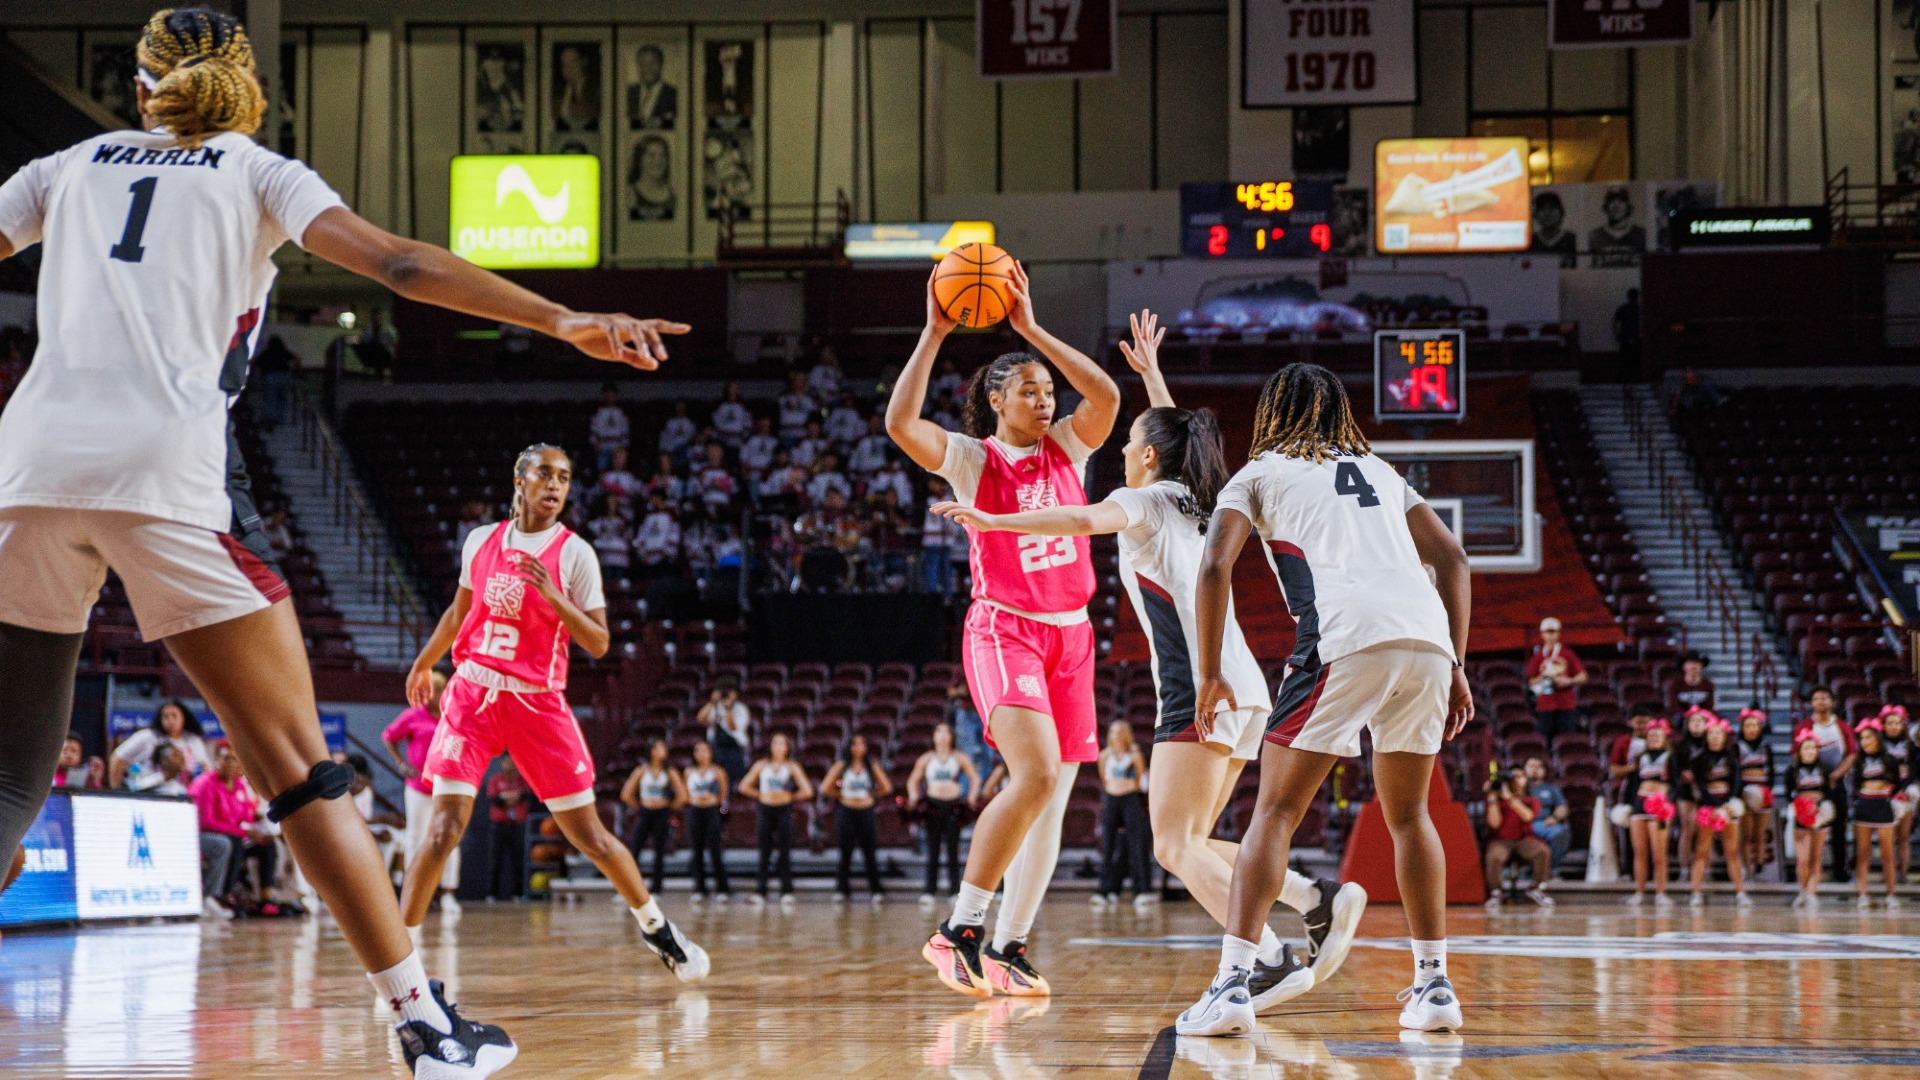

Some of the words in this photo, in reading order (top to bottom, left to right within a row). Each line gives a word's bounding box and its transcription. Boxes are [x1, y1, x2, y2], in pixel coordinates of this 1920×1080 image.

[1010, 0, 1082, 43] 157
[1287, 7, 1371, 38] FOUR
[1599, 14, 1645, 33] WINS
[1025, 47, 1070, 66] WINS
[1285, 51, 1376, 92] 1970
[92, 144, 226, 170] WARREN
[1236, 182, 1294, 211] 4:56
[110, 177, 158, 263] 1
[1208, 225, 1228, 255] 2
[1256, 228, 1266, 250] 1
[1310, 223, 1331, 252] 9
[1423, 341, 1453, 364] 56
[1410, 365, 1447, 408] 19
[1335, 461, 1381, 507] 4
[1017, 534, 1077, 573] 23
[477, 621, 519, 662] 12
